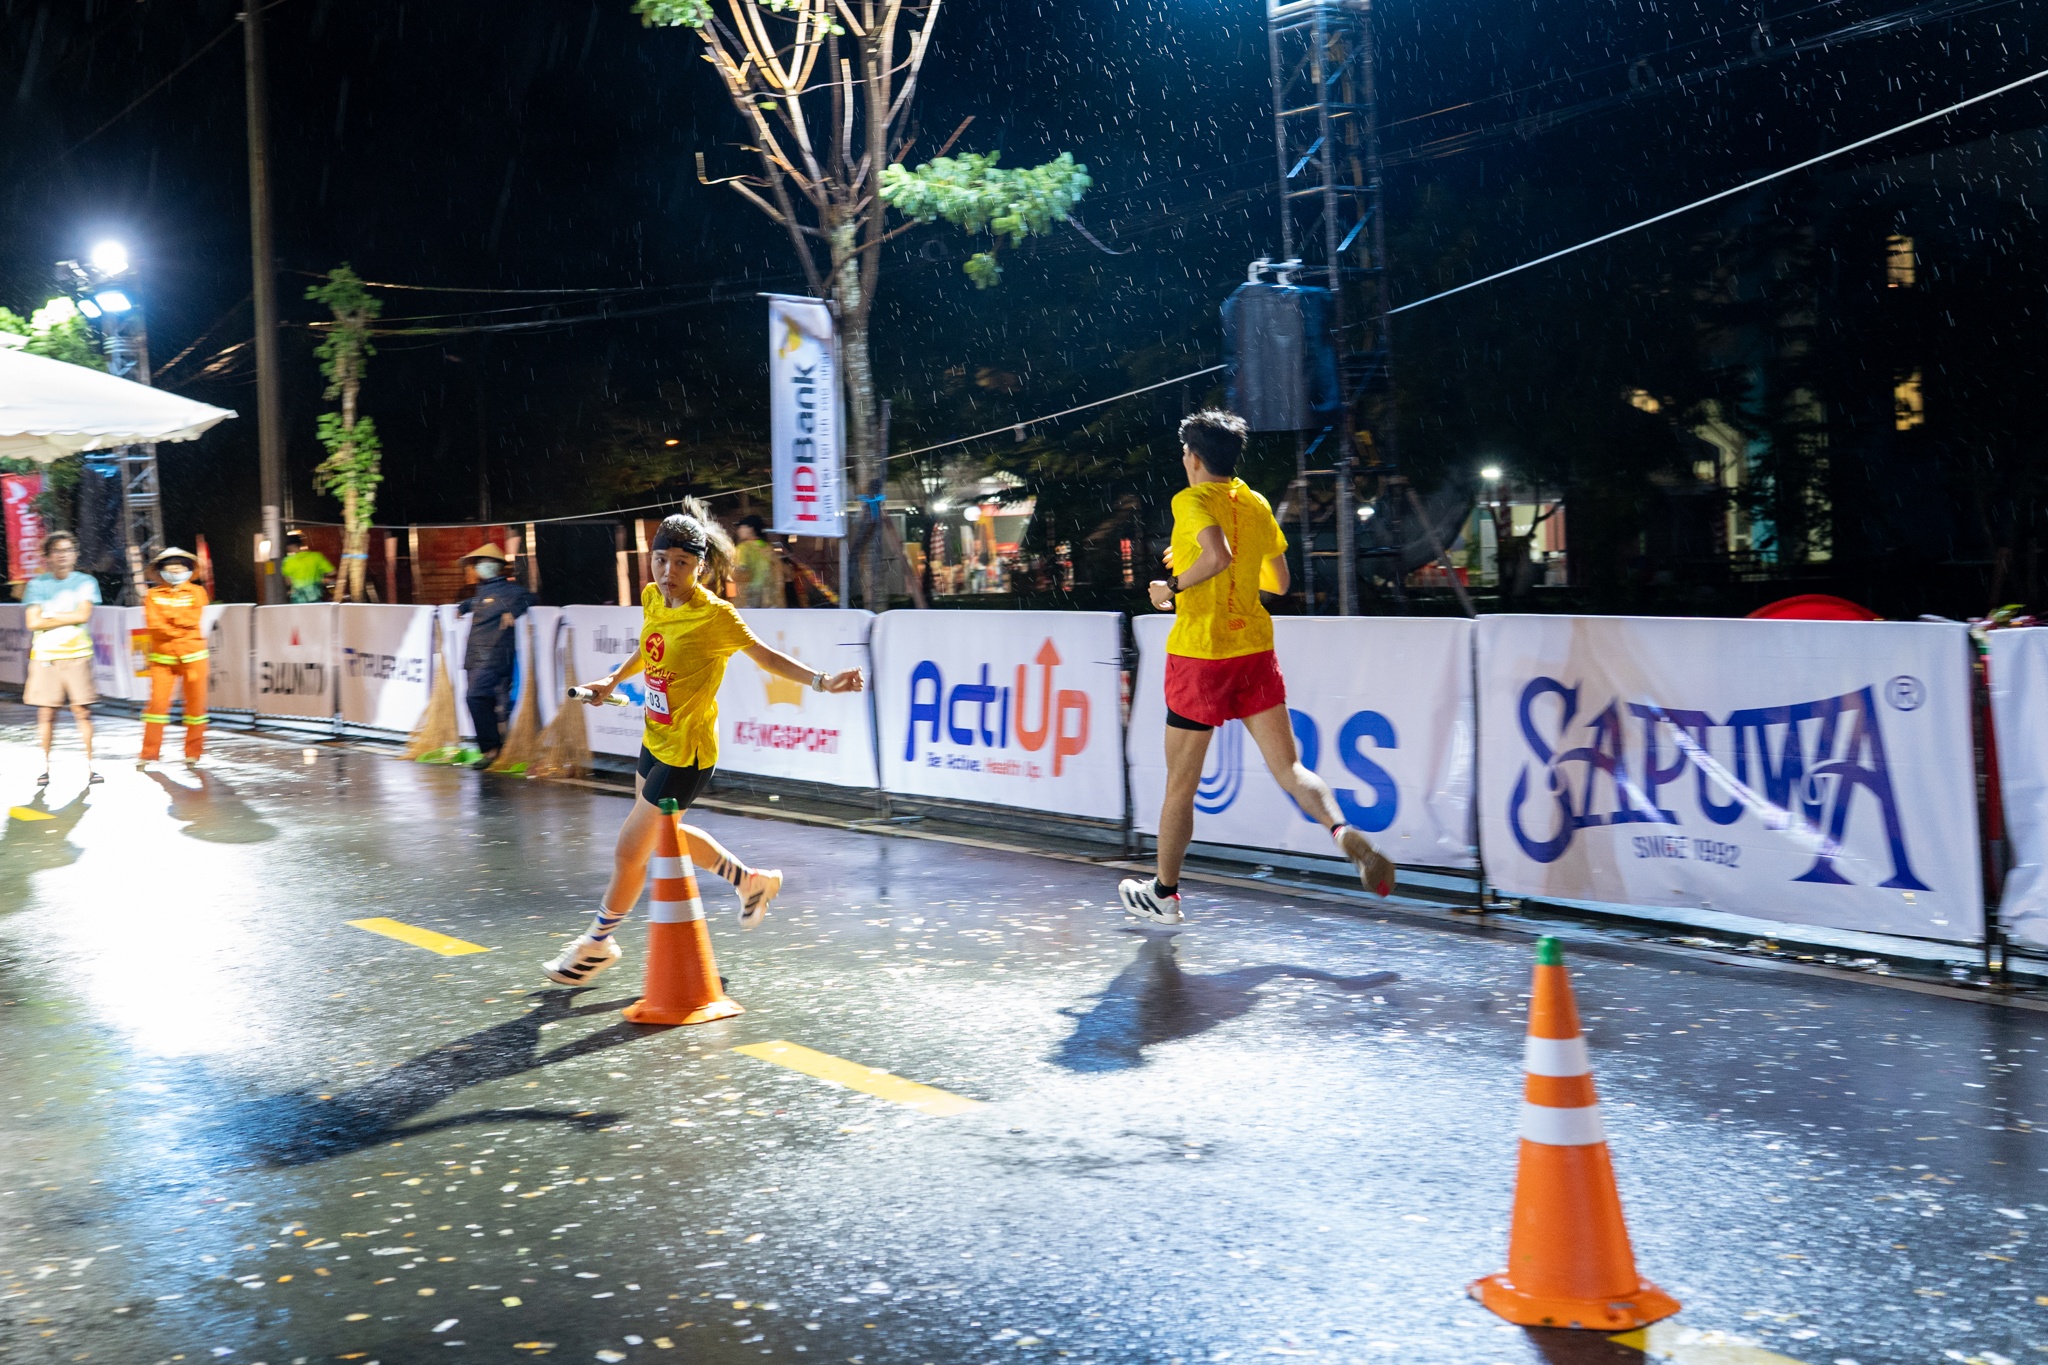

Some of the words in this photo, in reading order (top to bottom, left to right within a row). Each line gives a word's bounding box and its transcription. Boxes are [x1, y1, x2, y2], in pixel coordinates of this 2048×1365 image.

[791, 363, 819, 521] HDBank
[1509, 676, 1935, 891] SAPUWA
[1631, 835, 1689, 859] SINCE
